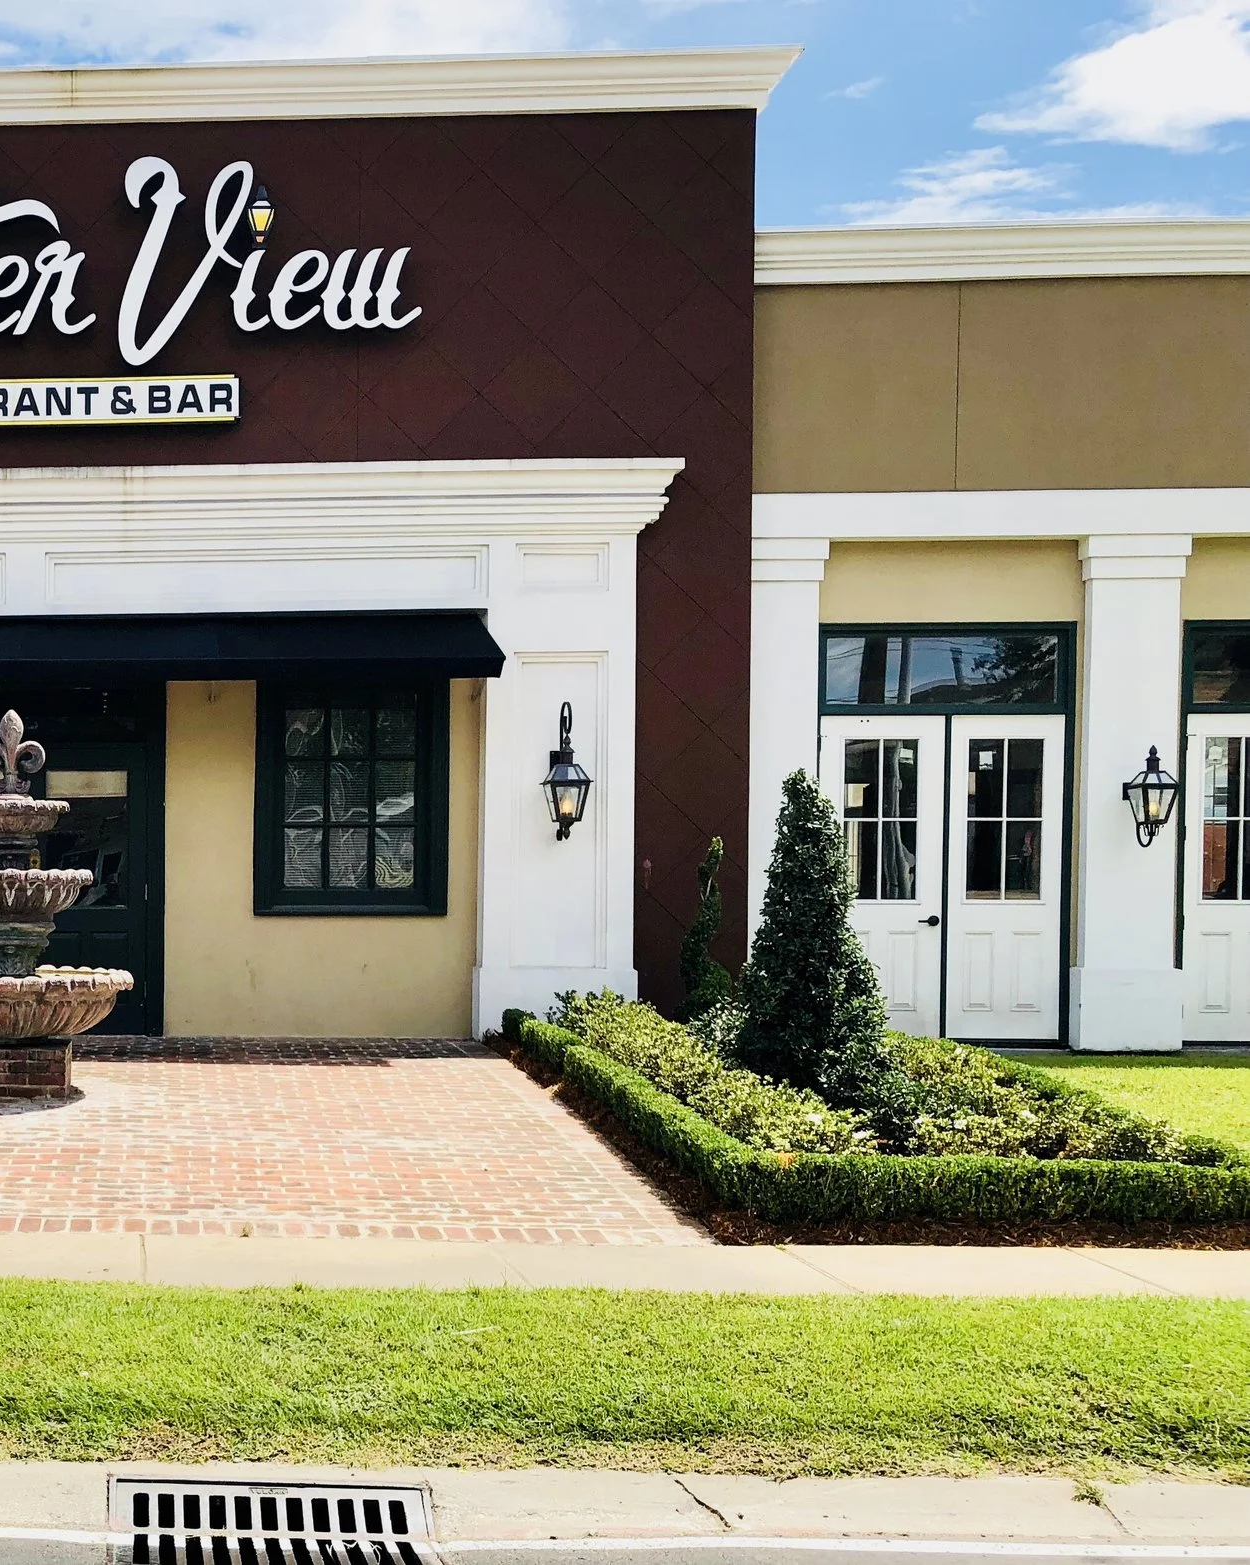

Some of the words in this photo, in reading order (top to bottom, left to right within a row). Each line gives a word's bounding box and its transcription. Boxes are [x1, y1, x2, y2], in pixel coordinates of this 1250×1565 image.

[118, 156, 423, 366] View
[110, 385, 138, 415] &
[148, 384, 233, 414] BAR
